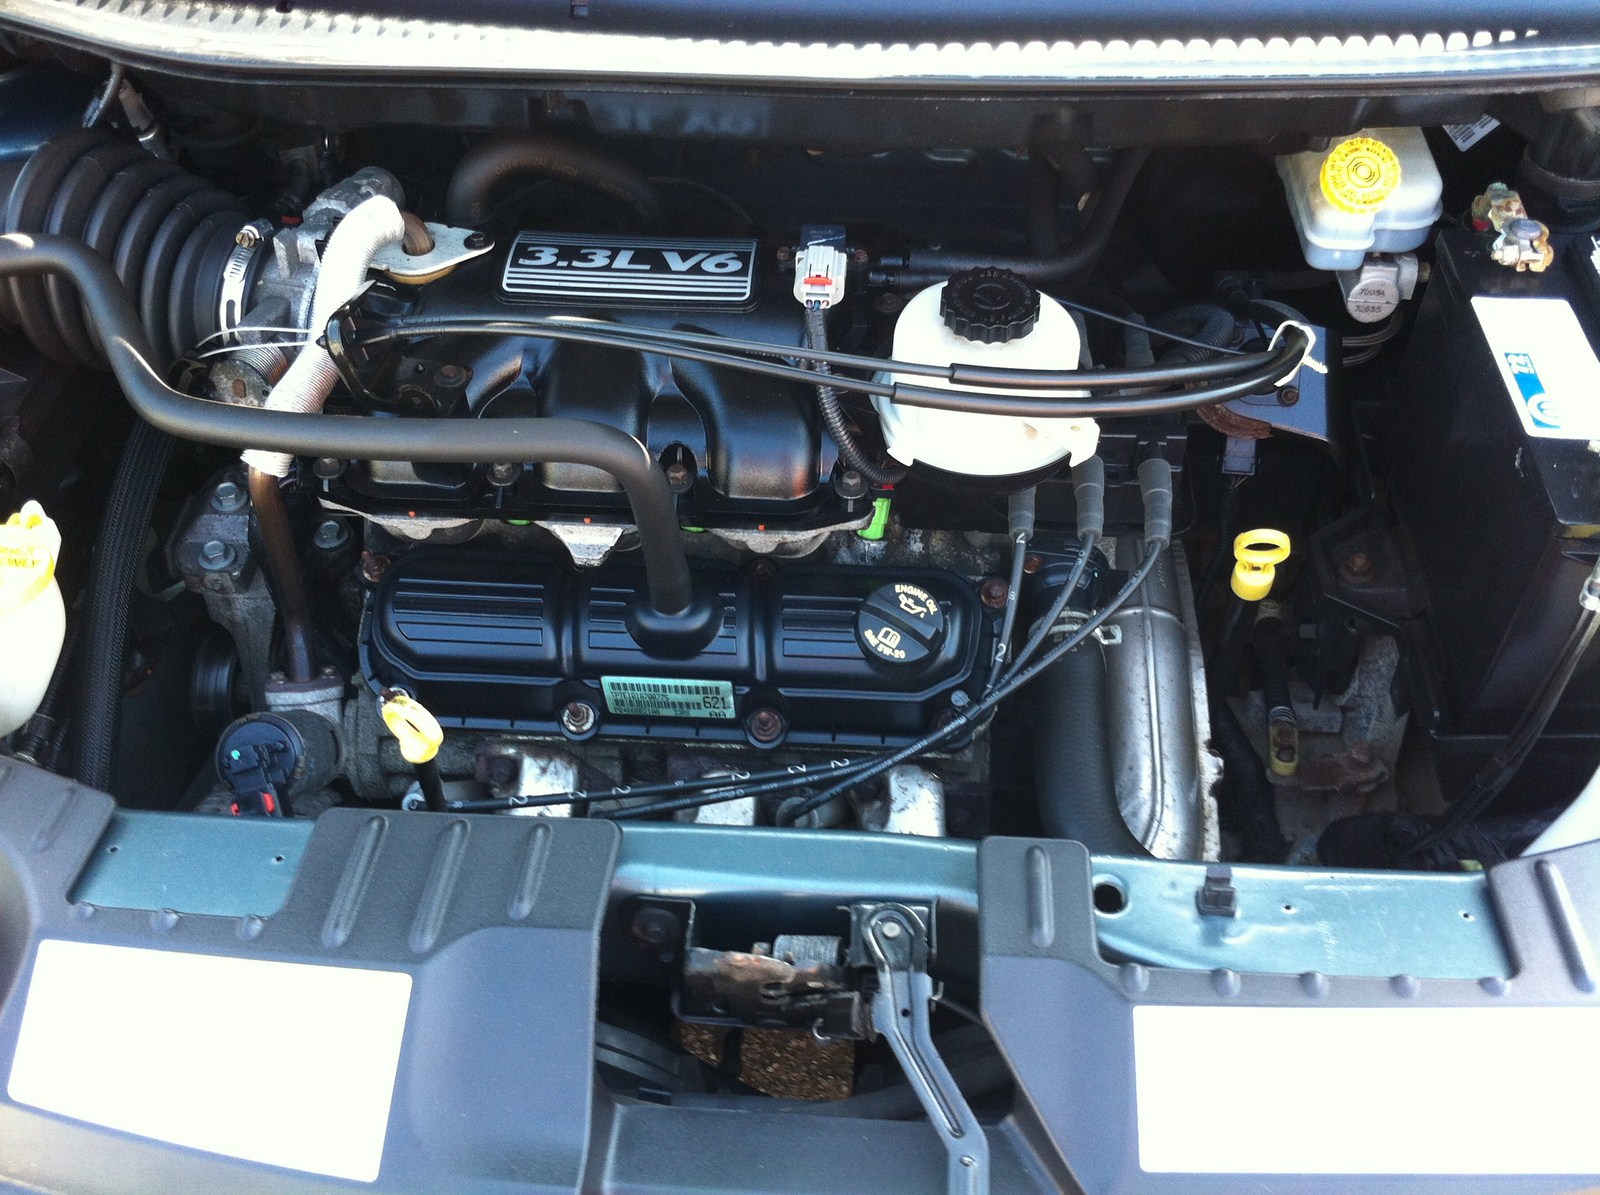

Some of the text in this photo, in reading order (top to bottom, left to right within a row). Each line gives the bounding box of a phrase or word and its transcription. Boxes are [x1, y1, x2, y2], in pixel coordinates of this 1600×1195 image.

[518, 246, 743, 274] 3.3L V6
[894, 584, 938, 616] ENGINE OIL
[877, 644, 906, 659] 5W-20
[702, 696, 727, 710] 621
